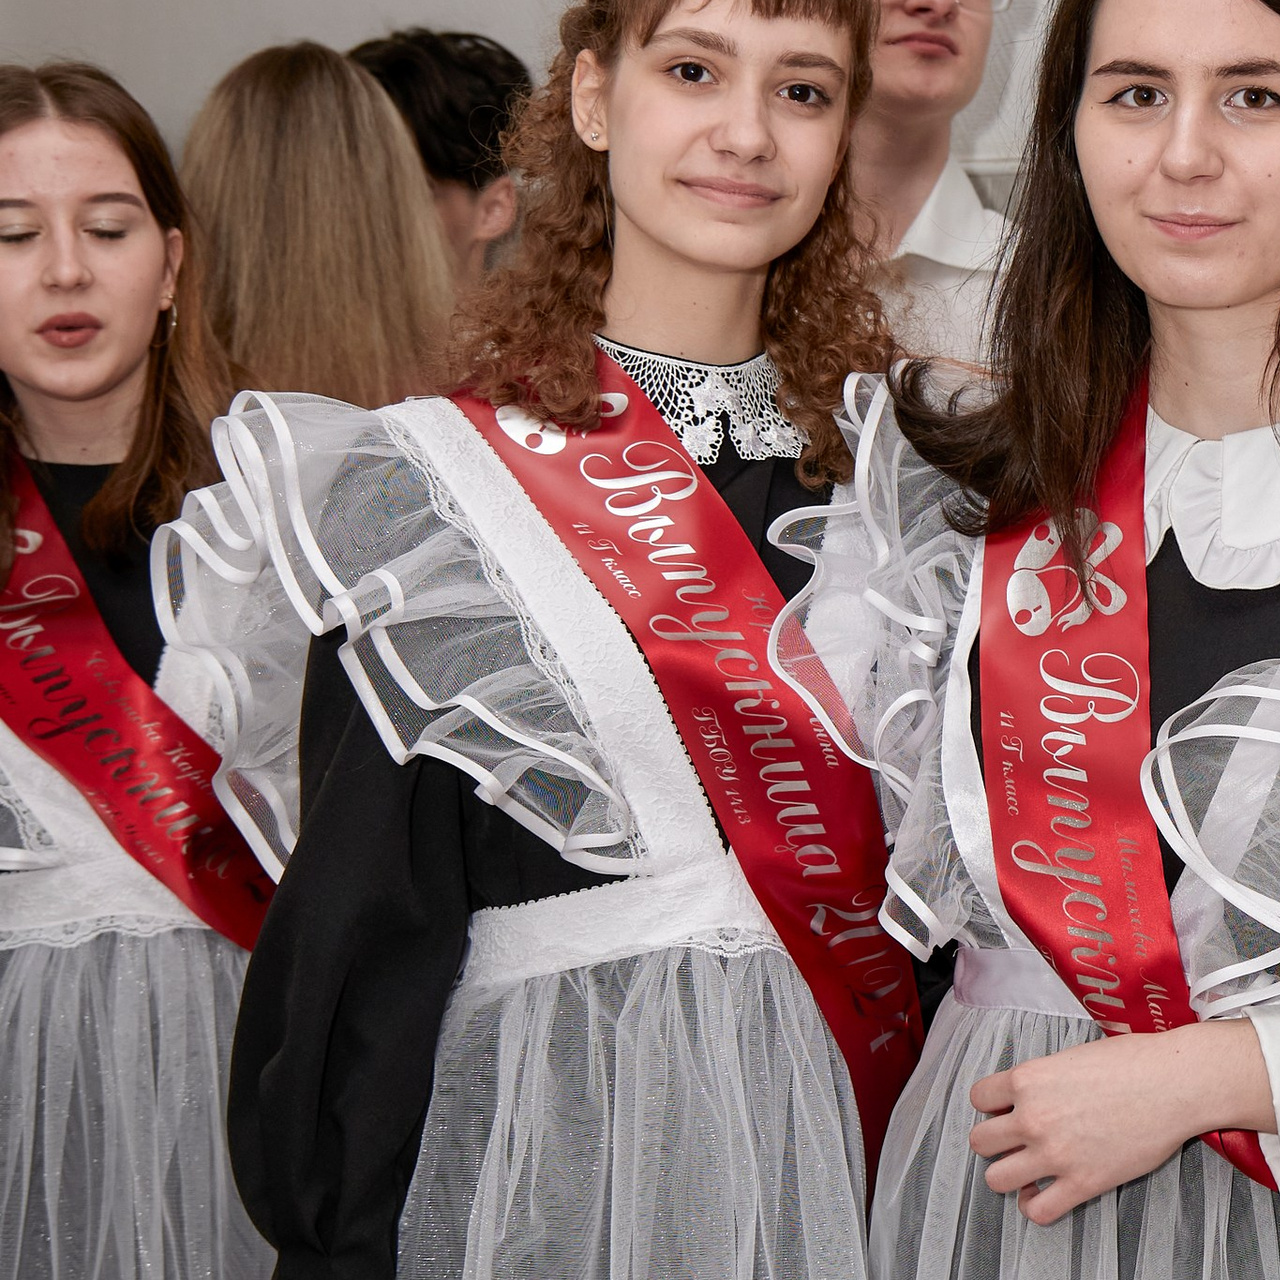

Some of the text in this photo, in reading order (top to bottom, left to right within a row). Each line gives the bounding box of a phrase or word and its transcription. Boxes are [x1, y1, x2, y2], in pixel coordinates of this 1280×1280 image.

[571, 521, 642, 599] 11 Г класс
[579, 440, 842, 877] Выпускница
[692, 706, 750, 825] ГБОУ 1413
[1000, 710, 1024, 816] 11 Г класс
[1114, 823, 1154, 959] Малахова
